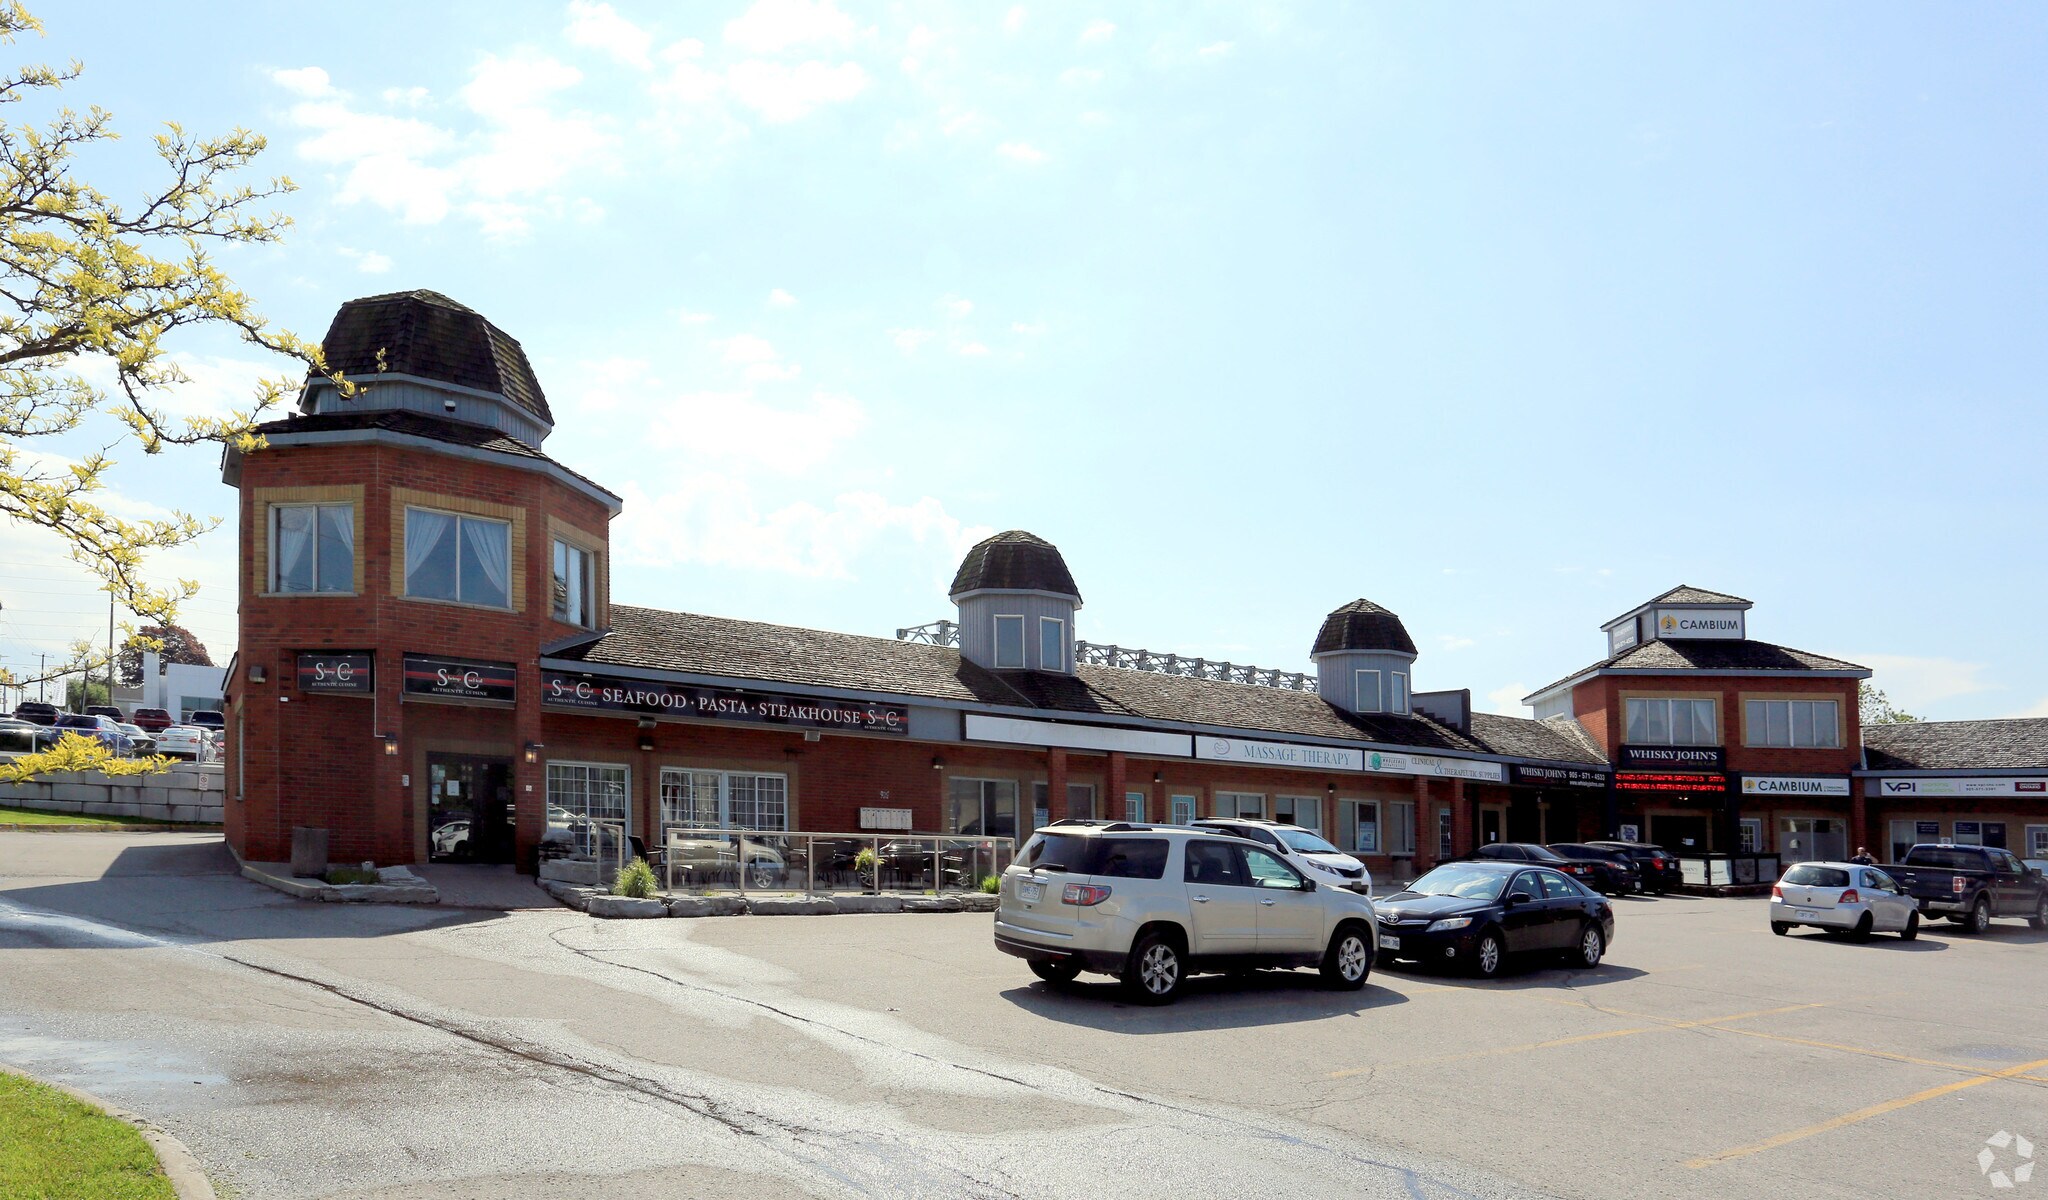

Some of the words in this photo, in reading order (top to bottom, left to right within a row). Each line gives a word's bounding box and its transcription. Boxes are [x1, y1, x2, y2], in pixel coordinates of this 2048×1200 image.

[1680, 620, 1738, 630] CAMBIUM
[602, 688, 686, 708] SEAFOOD
[699, 697, 748, 714] PASTA
[759, 702, 860, 724] STEAKHOUSE
[1244, 744, 1296, 762] MASSAGE
[1302, 750, 1350, 765] THERAPY
[1630, 750, 1675, 759] WHISKY
[1676, 751, 1718, 761] JOHN'S
[1412, 757, 1434, 766] CLINICAL
[1520, 767, 1544, 777] WHISKY
[1544, 768, 1566, 778] JOHN'S
[1758, 781, 1822, 792] CAMBIUM
[1885, 782, 1916, 792] VPI
